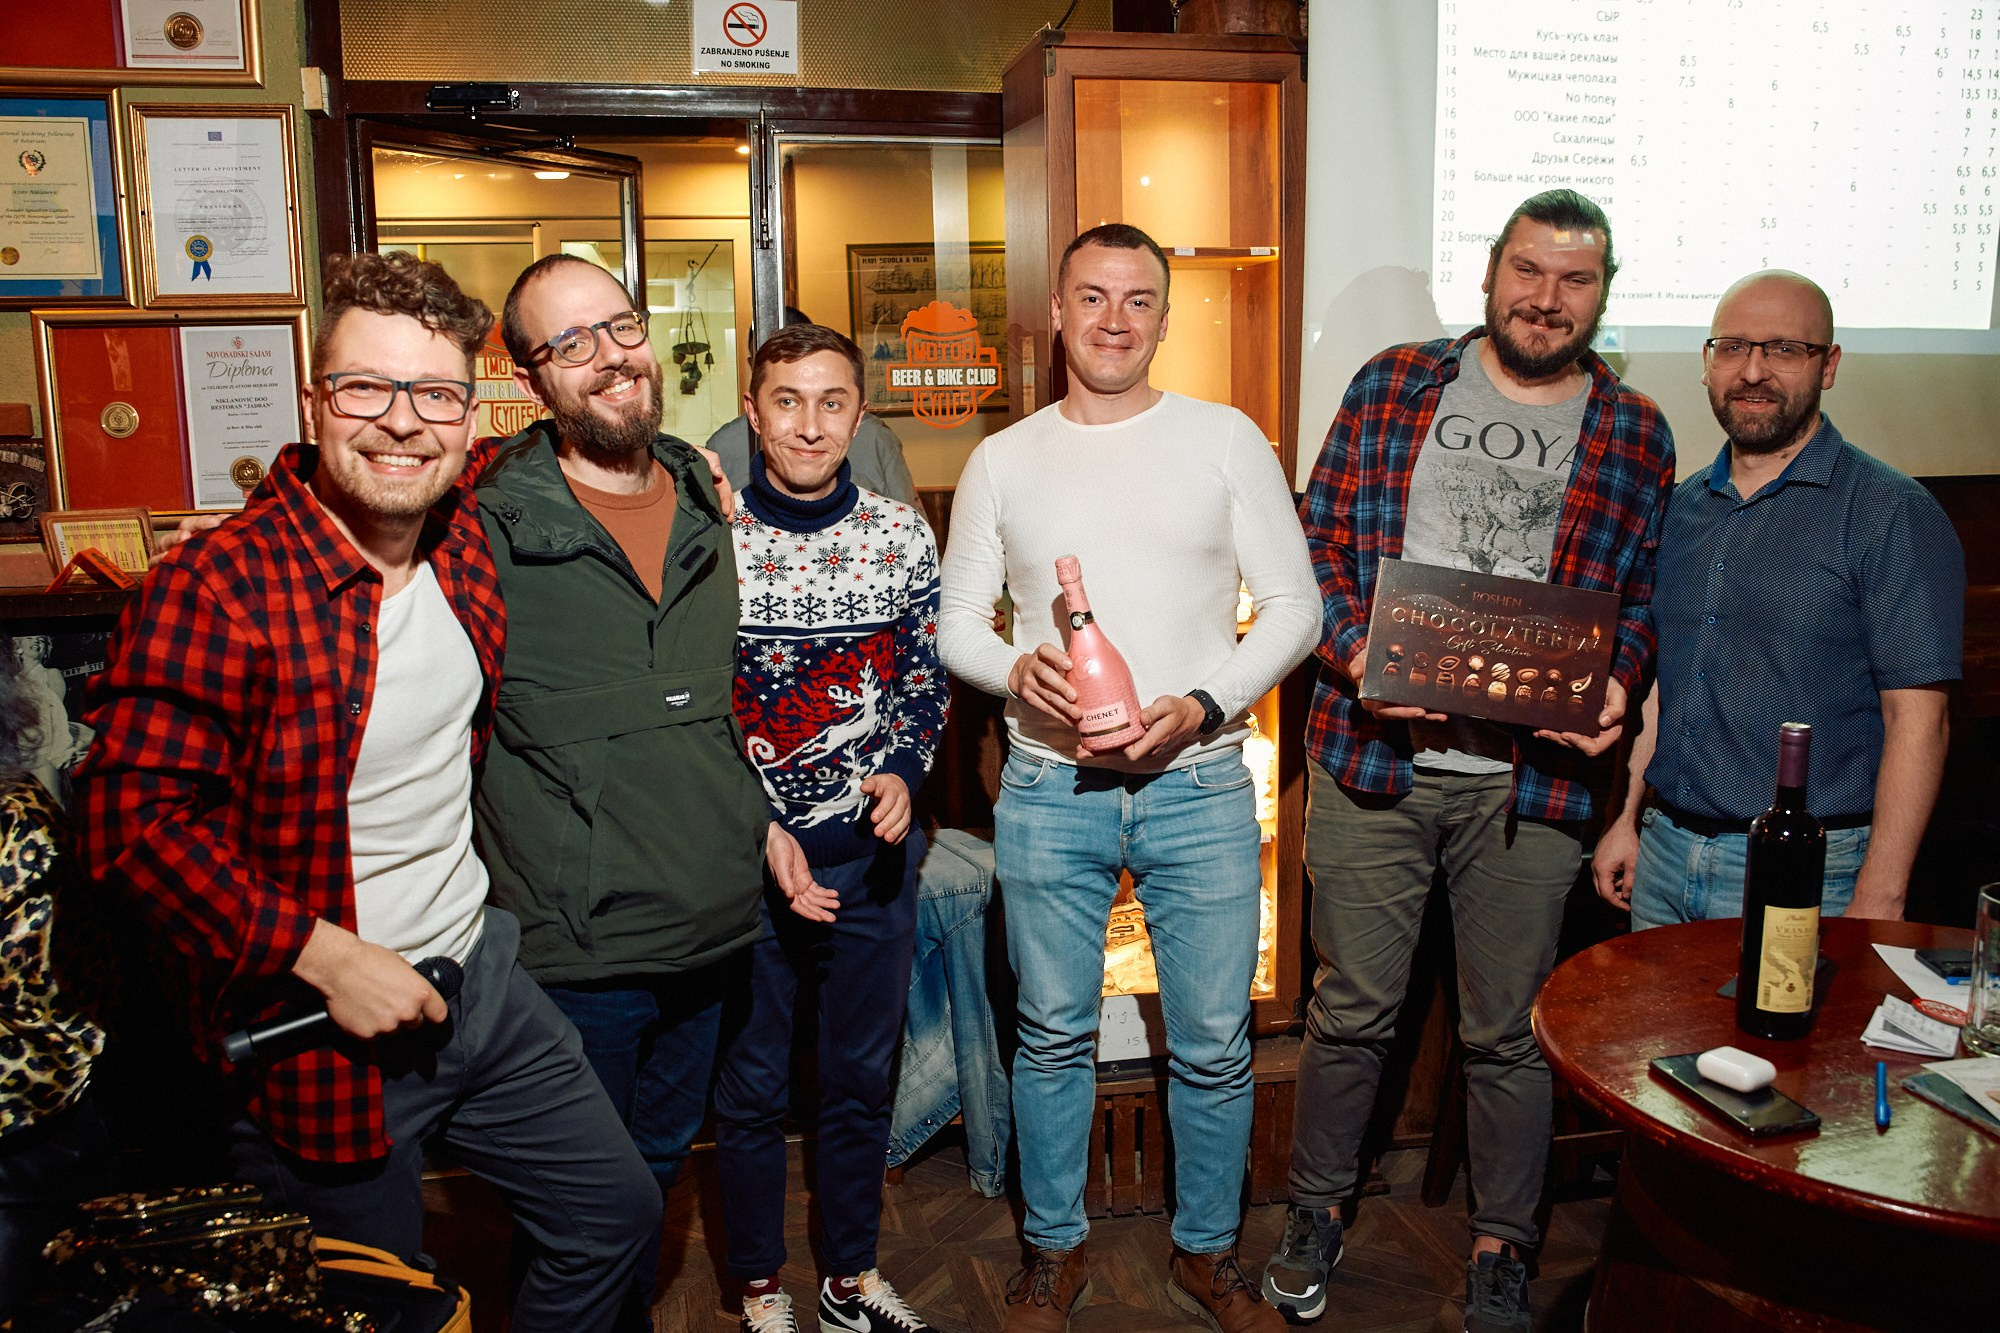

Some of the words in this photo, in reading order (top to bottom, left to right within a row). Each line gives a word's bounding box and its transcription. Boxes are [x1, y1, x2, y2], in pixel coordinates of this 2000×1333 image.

[1446, 3, 1456, 14] 11
[1596, 10, 1620, 22] СЫР
[1812, 21, 1829, 34] 6,5
[1895, 25, 1911, 38] 6,5
[1940, 27, 1947, 39] 5
[1970, 29, 1982, 41] 18
[1970, 9, 1983, 21] 23
[701, 47, 753, 56] ZABRANJENO
[755, 49, 790, 58] PUŠENJE
[1446, 24, 1457, 35] 12
[1536, 29, 1589, 42] Кусь-кусь
[1593, 32, 1618, 43] клан
[1854, 43, 1870, 56] 5,5
[1900, 45, 1906, 57] 7
[1934, 47, 1949, 60] 4,5
[1968, 49, 1980, 61] 17
[721, 60, 732, 68] NO
[734, 61, 770, 69] SMOKING
[1446, 45, 1457, 57] 13
[1473, 47, 1507, 58] Место
[1509, 51, 1528, 60] для
[1532, 50, 1566, 61] вашей
[1570, 53, 1618, 64] рекламы
[1680, 55, 1697, 68] 8,5
[1937, 67, 1944, 79] 6
[1962, 68, 1982, 81] 14,5
[1445, 66, 1457, 77] 14
[1508, 69, 1562, 82] Мужицкая
[1566, 73, 1617, 84] чеполаха
[1679, 76, 1696, 89] 7,5
[1771, 80, 1779, 91] 6
[1961, 88, 1981, 101] 13,5
[1445, 87, 1456, 98] 15
[1566, 92, 1581, 104] No
[1584, 92, 1617, 106] honey
[1728, 98, 1734, 109] 8
[1965, 108, 1972, 119] 8
[1991, 108, 1998, 119] 8
[1444, 108, 1457, 119] 16
[1812, 121, 1819, 132] 7
[1964, 128, 1971, 138] 7
[1990, 128, 1997, 138] 7
[1444, 128, 1456, 140] 16
[1553, 132, 1615, 146] Сахалинцы
[1637, 135, 1644, 146] 7
[1963, 147, 1969, 157] 7
[1988, 147, 1995, 158] 7
[1443, 149, 1456, 160] 18
[1532, 152, 1569, 165] Друзья
[1573, 153, 1614, 166] Серёжи
[1630, 155, 1648, 168] 6,5
[1956, 165, 1971, 178] 6,5
[1981, 166, 1997, 179] 6,5
[1443, 169, 1456, 181] 19
[1474, 170, 1513, 182] Больше
[1517, 173, 1535, 183] нас
[1538, 175, 1572, 185] кроме
[1575, 174, 1614, 185] никого
[1850, 181, 1857, 192] 6
[1959, 185, 1966, 196] 6
[1984, 185, 1991, 196] 6
[1441, 190, 1455, 201] 20
[1923, 203, 1937, 215] 5,5
[1954, 204, 1968, 216] 5,5
[1978, 204, 1993, 217] 5,5
[1441, 210, 1455, 222] 20
[1760, 217, 1777, 230] 5,5
[1952, 223, 1966, 236] 5,5
[1976, 223, 1991, 236] 5,5
[1440, 231, 1454, 242] 22
[1676, 235, 1684, 247] 5
[1955, 242, 1961, 253] 5
[1980, 242, 1985, 254] 5
[1440, 252, 1453, 263] 22
[1762, 257, 1768, 268] 5
[1954, 261, 1959, 272] 5
[1978, 261, 1983, 272] 5
[1439, 271, 1453, 283] 22
[1843, 277, 1849, 289] 5
[1952, 279, 1958, 291] 5
[1976, 280, 1982, 291] 5
[206, 351, 249, 359] NOVOSADSKI
[249, 350, 271, 358] SAJAM
[914, 340, 973, 362] MOTOR
[206, 358, 273, 383] Diploma
[490, 354, 514, 375] MOT
[893, 370, 921, 385] BEER
[925, 370, 934, 385] &
[937, 370, 963, 385] BIKE
[967, 369, 996, 385] CLUB
[919, 391, 970, 420] CYCLES
[1472, 591, 1522, 607] ROSHEN
[1446, 635, 1476, 652] Gift
[1479, 639, 1532, 657] Selection
[1087, 708, 1119, 721] CHENET
